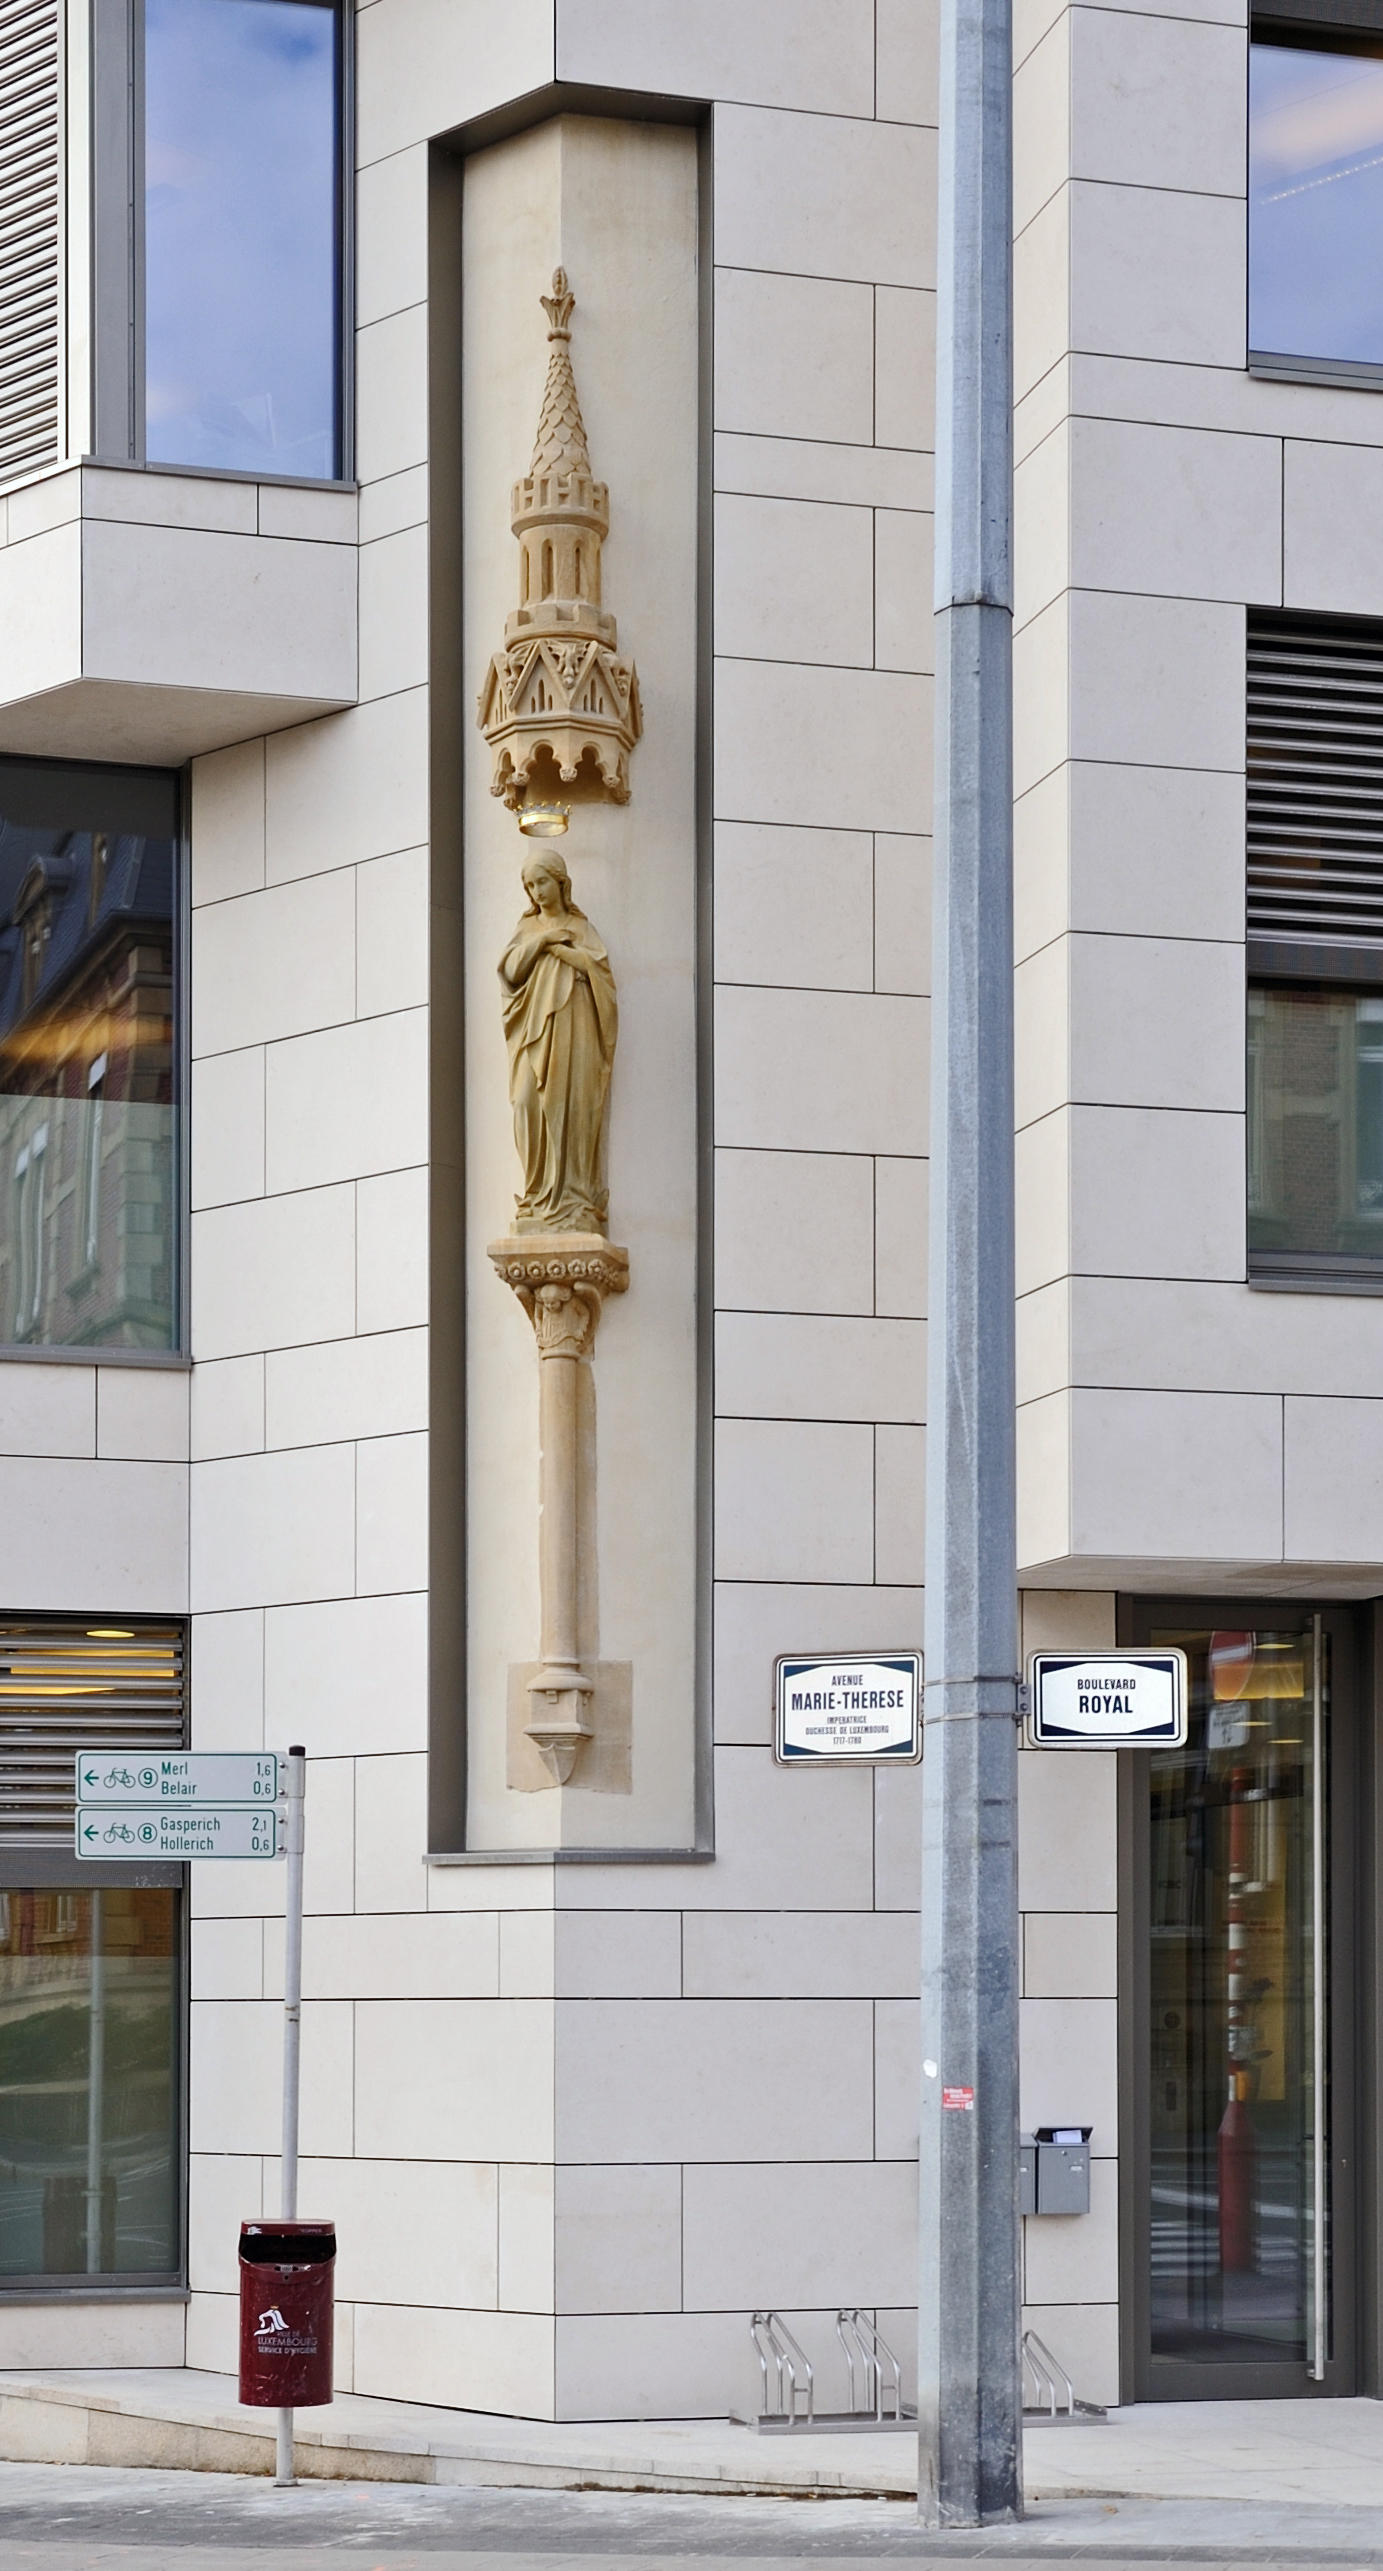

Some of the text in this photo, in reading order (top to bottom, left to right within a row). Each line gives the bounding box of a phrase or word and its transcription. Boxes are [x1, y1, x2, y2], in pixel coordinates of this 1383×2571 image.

[831, 1674, 864, 1686] AVENUE
[1077, 1679, 1136, 1690] BOULEVARD
[791, 1690, 904, 1710] MARIE-THERESE
[1079, 1695, 1133, 1714] ROYAL
[805, 1725, 889, 1735] DUCHESSE DE LUXEMBOURG
[833, 1737, 862, 1745] 1717-1780
[161, 1761, 271, 1777] Merl 1,6
[161, 1781, 271, 1796] Belair 0,6
[161, 1817, 266, 1834] Gasperich 2,1
[161, 1837, 269, 1852] Hollerich 0,6
[258, 2337, 318, 2346] LUXEMBOURG
